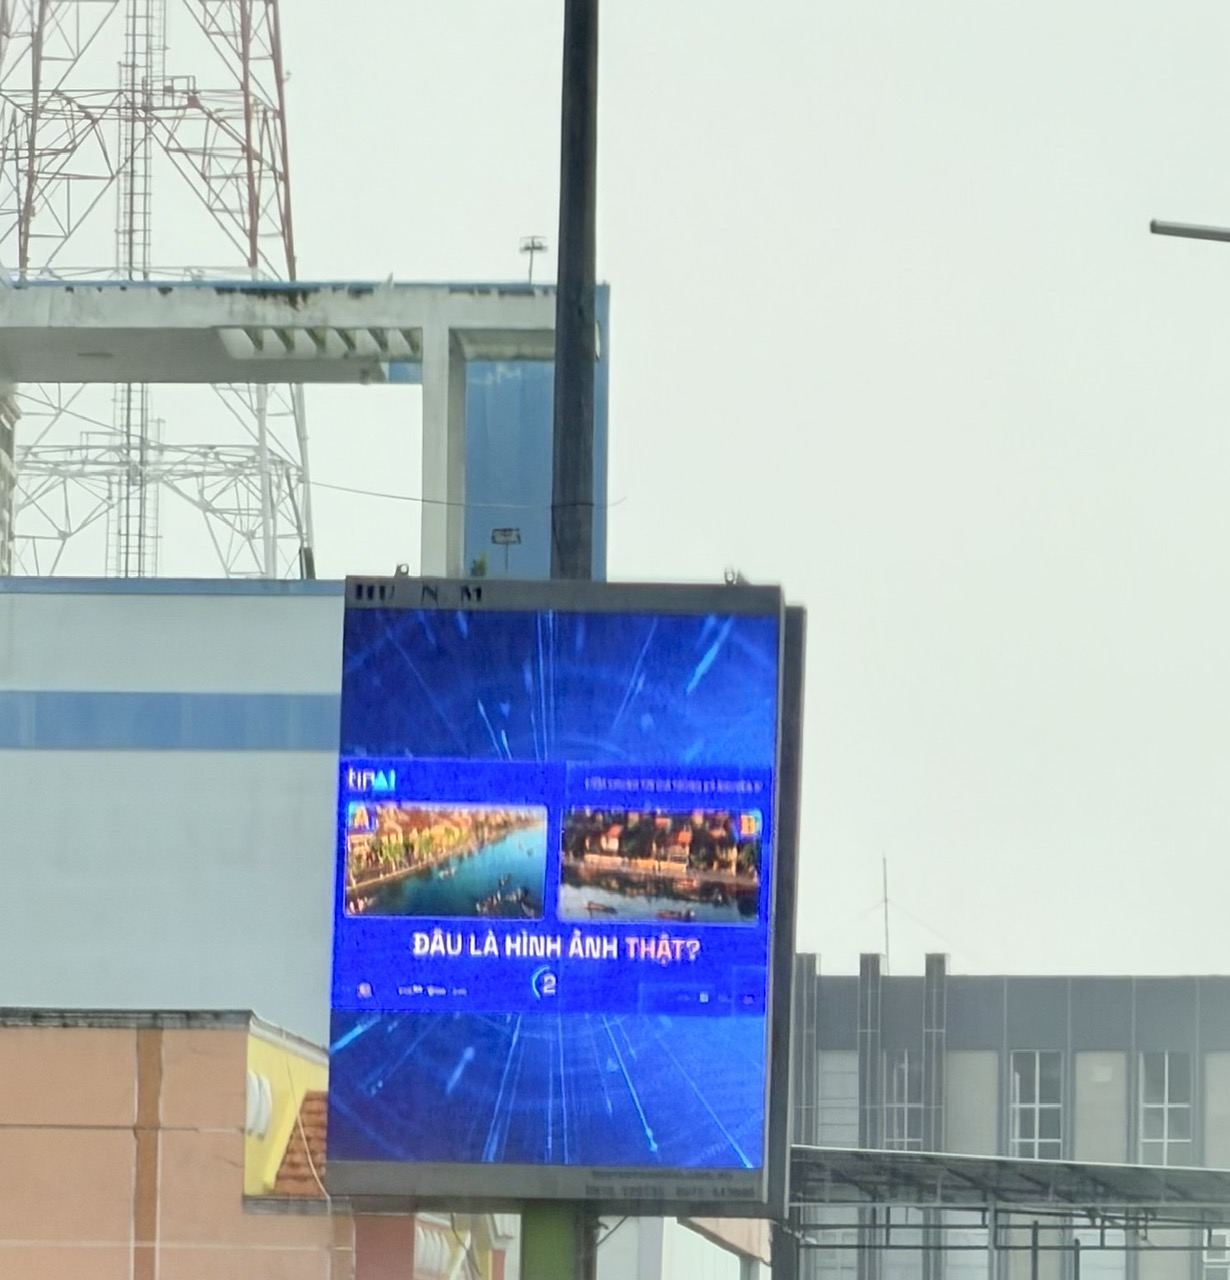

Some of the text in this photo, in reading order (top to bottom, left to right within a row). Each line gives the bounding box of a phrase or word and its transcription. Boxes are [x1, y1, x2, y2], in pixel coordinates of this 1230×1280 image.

[412, 928, 701, 966] ĐÂU LÀ HÌNH ẢNH THẬT?
